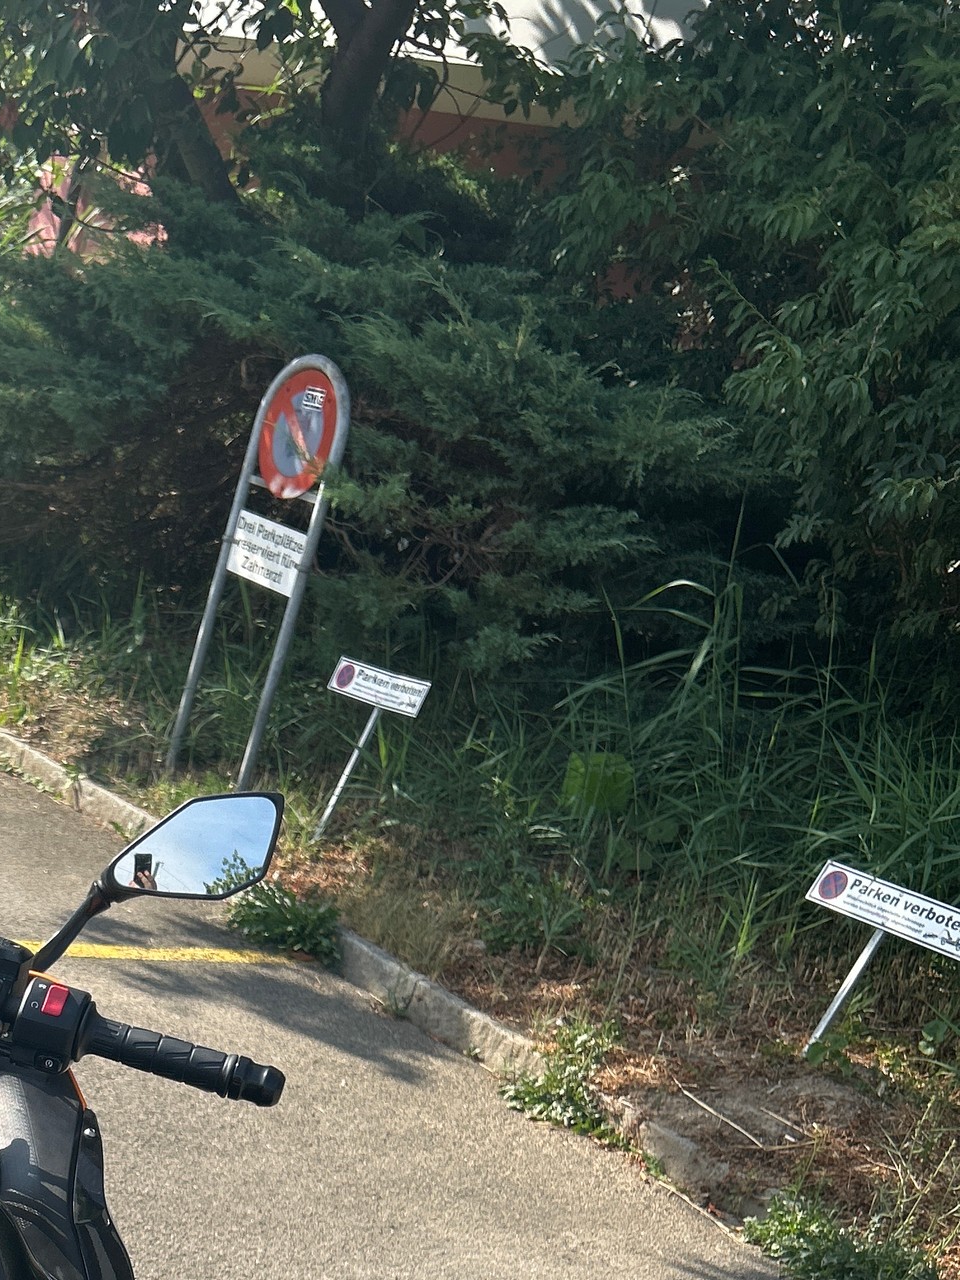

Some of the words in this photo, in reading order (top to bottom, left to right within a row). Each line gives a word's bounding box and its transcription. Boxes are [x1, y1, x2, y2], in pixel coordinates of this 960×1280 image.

[237, 516, 257, 534] Drei
[849, 878, 901, 908] Parken
[902, 901, 960, 932] verbote
